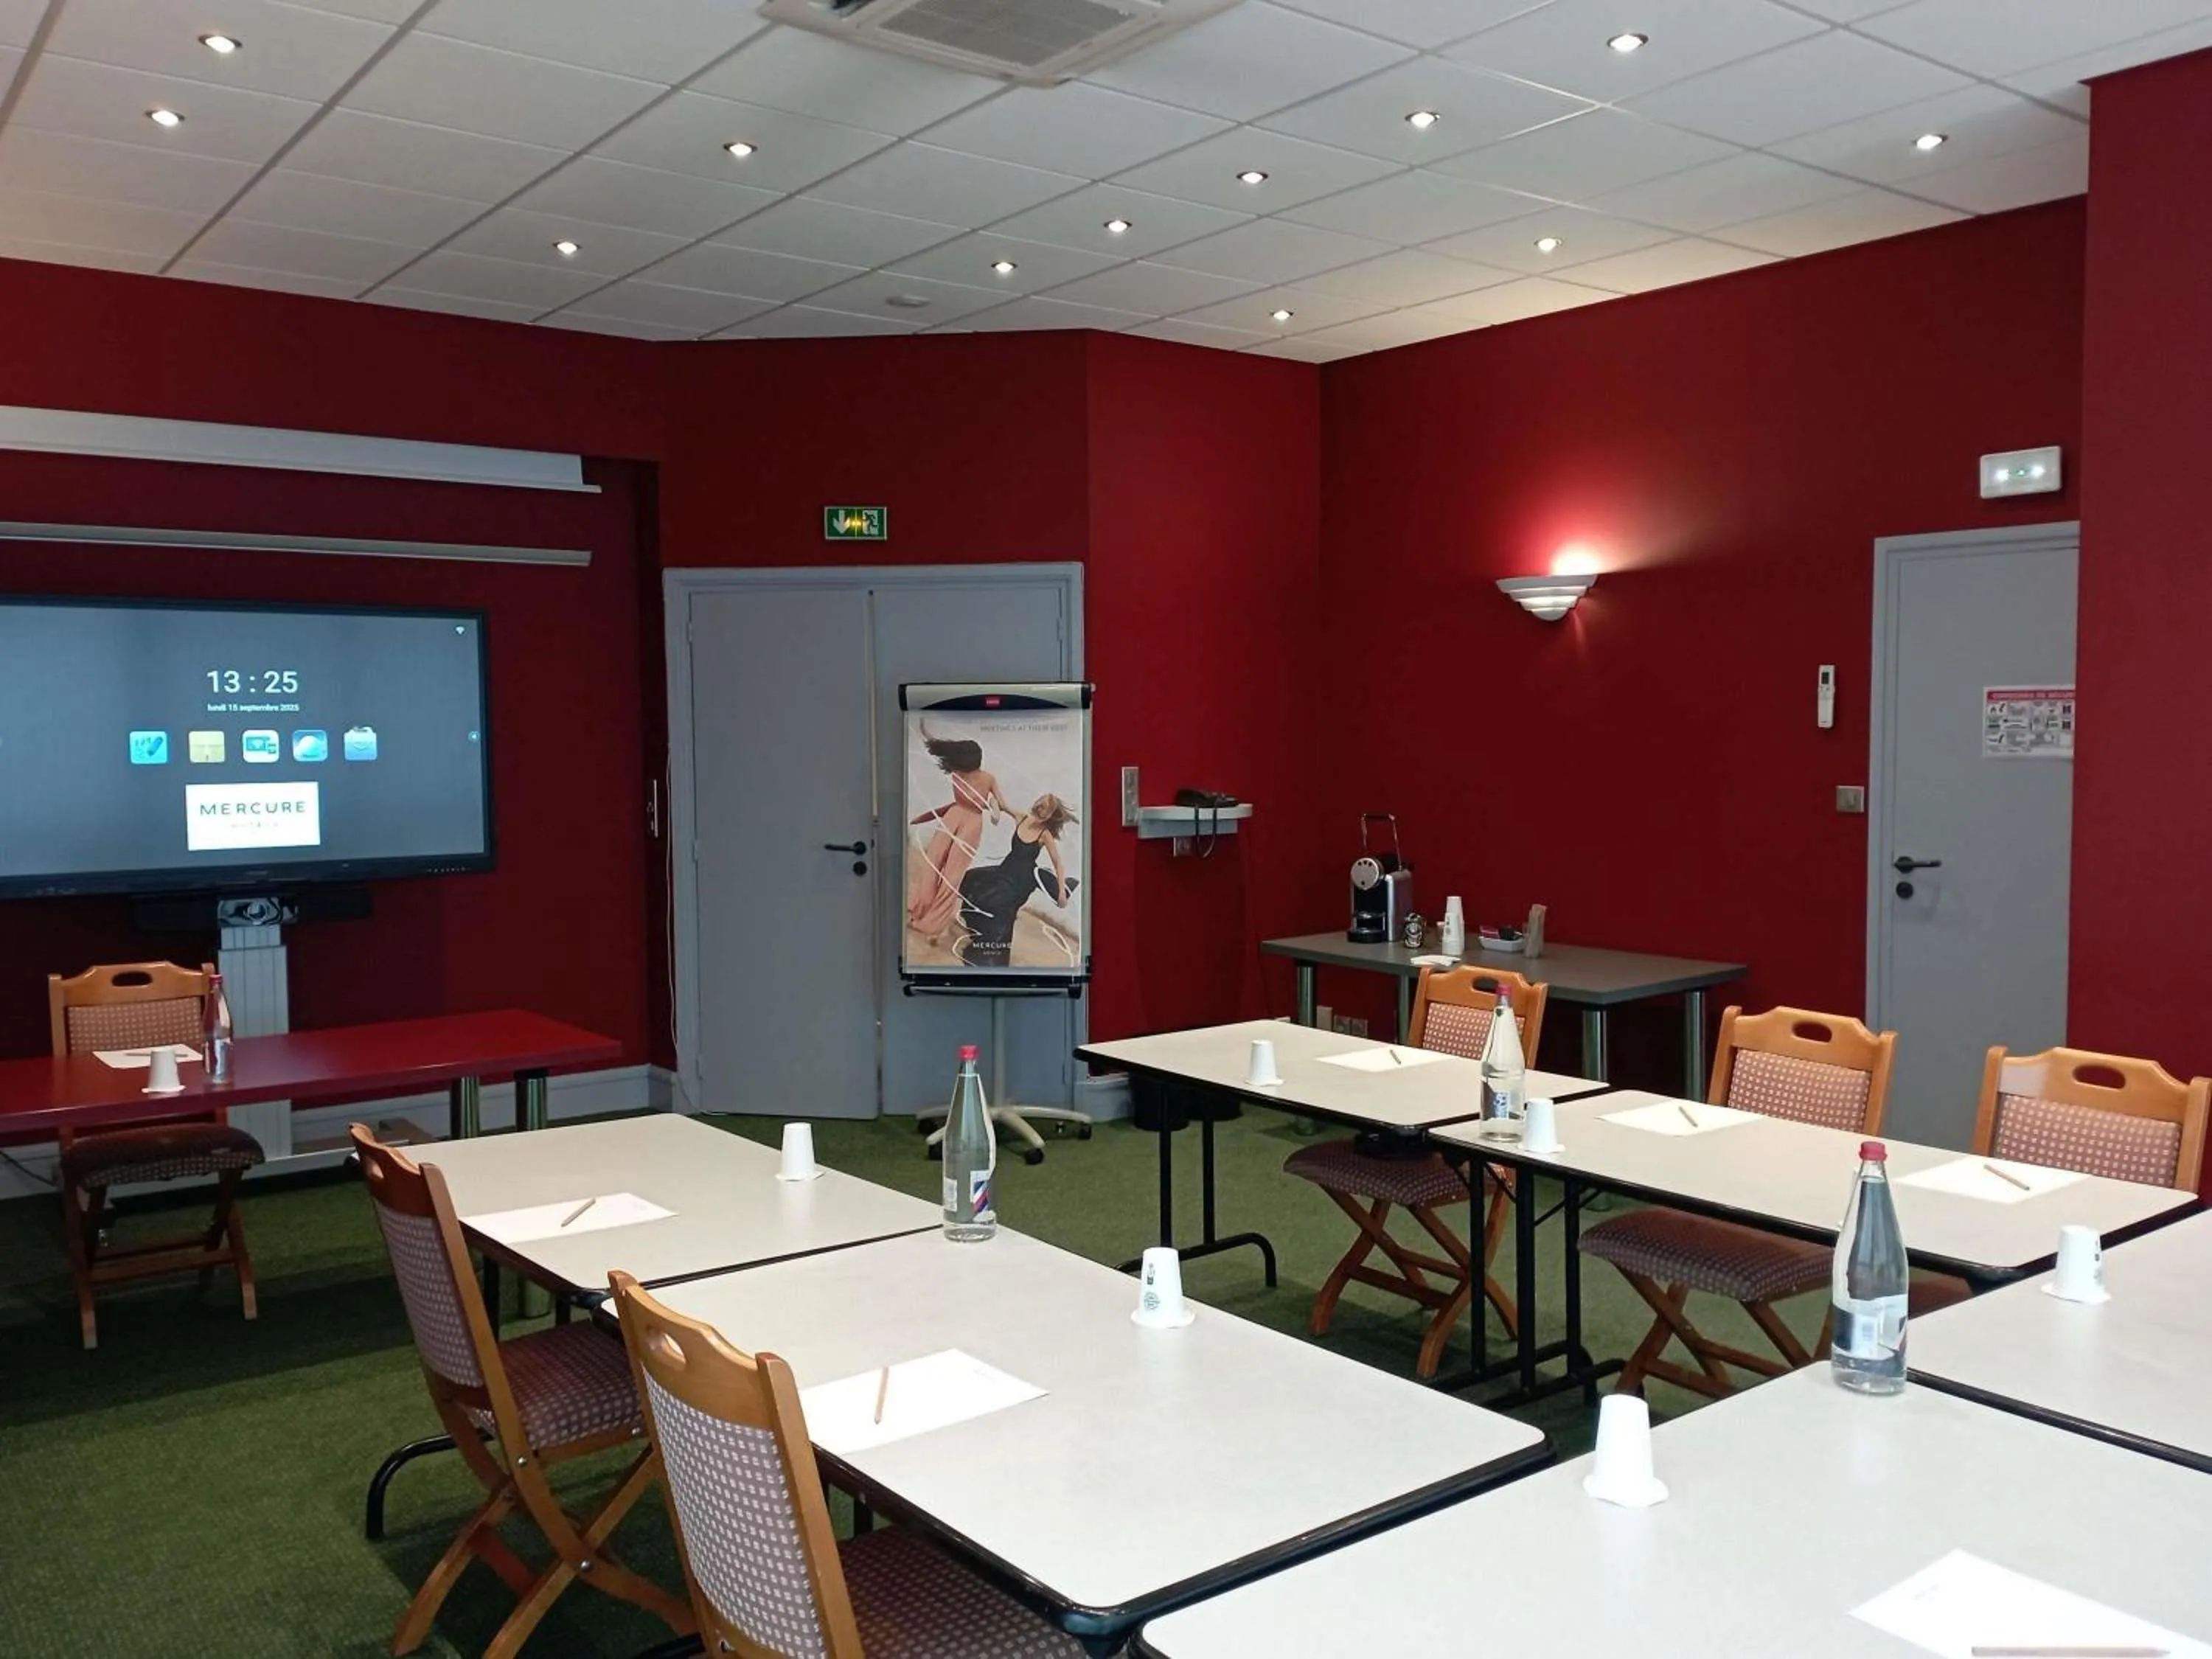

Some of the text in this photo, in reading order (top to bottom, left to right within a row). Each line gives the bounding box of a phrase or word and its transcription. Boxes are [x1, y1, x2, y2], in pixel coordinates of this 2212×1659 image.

[207, 670, 240, 693] 13
[264, 670, 298, 693] 25
[200, 801, 306, 815] MERCURE
